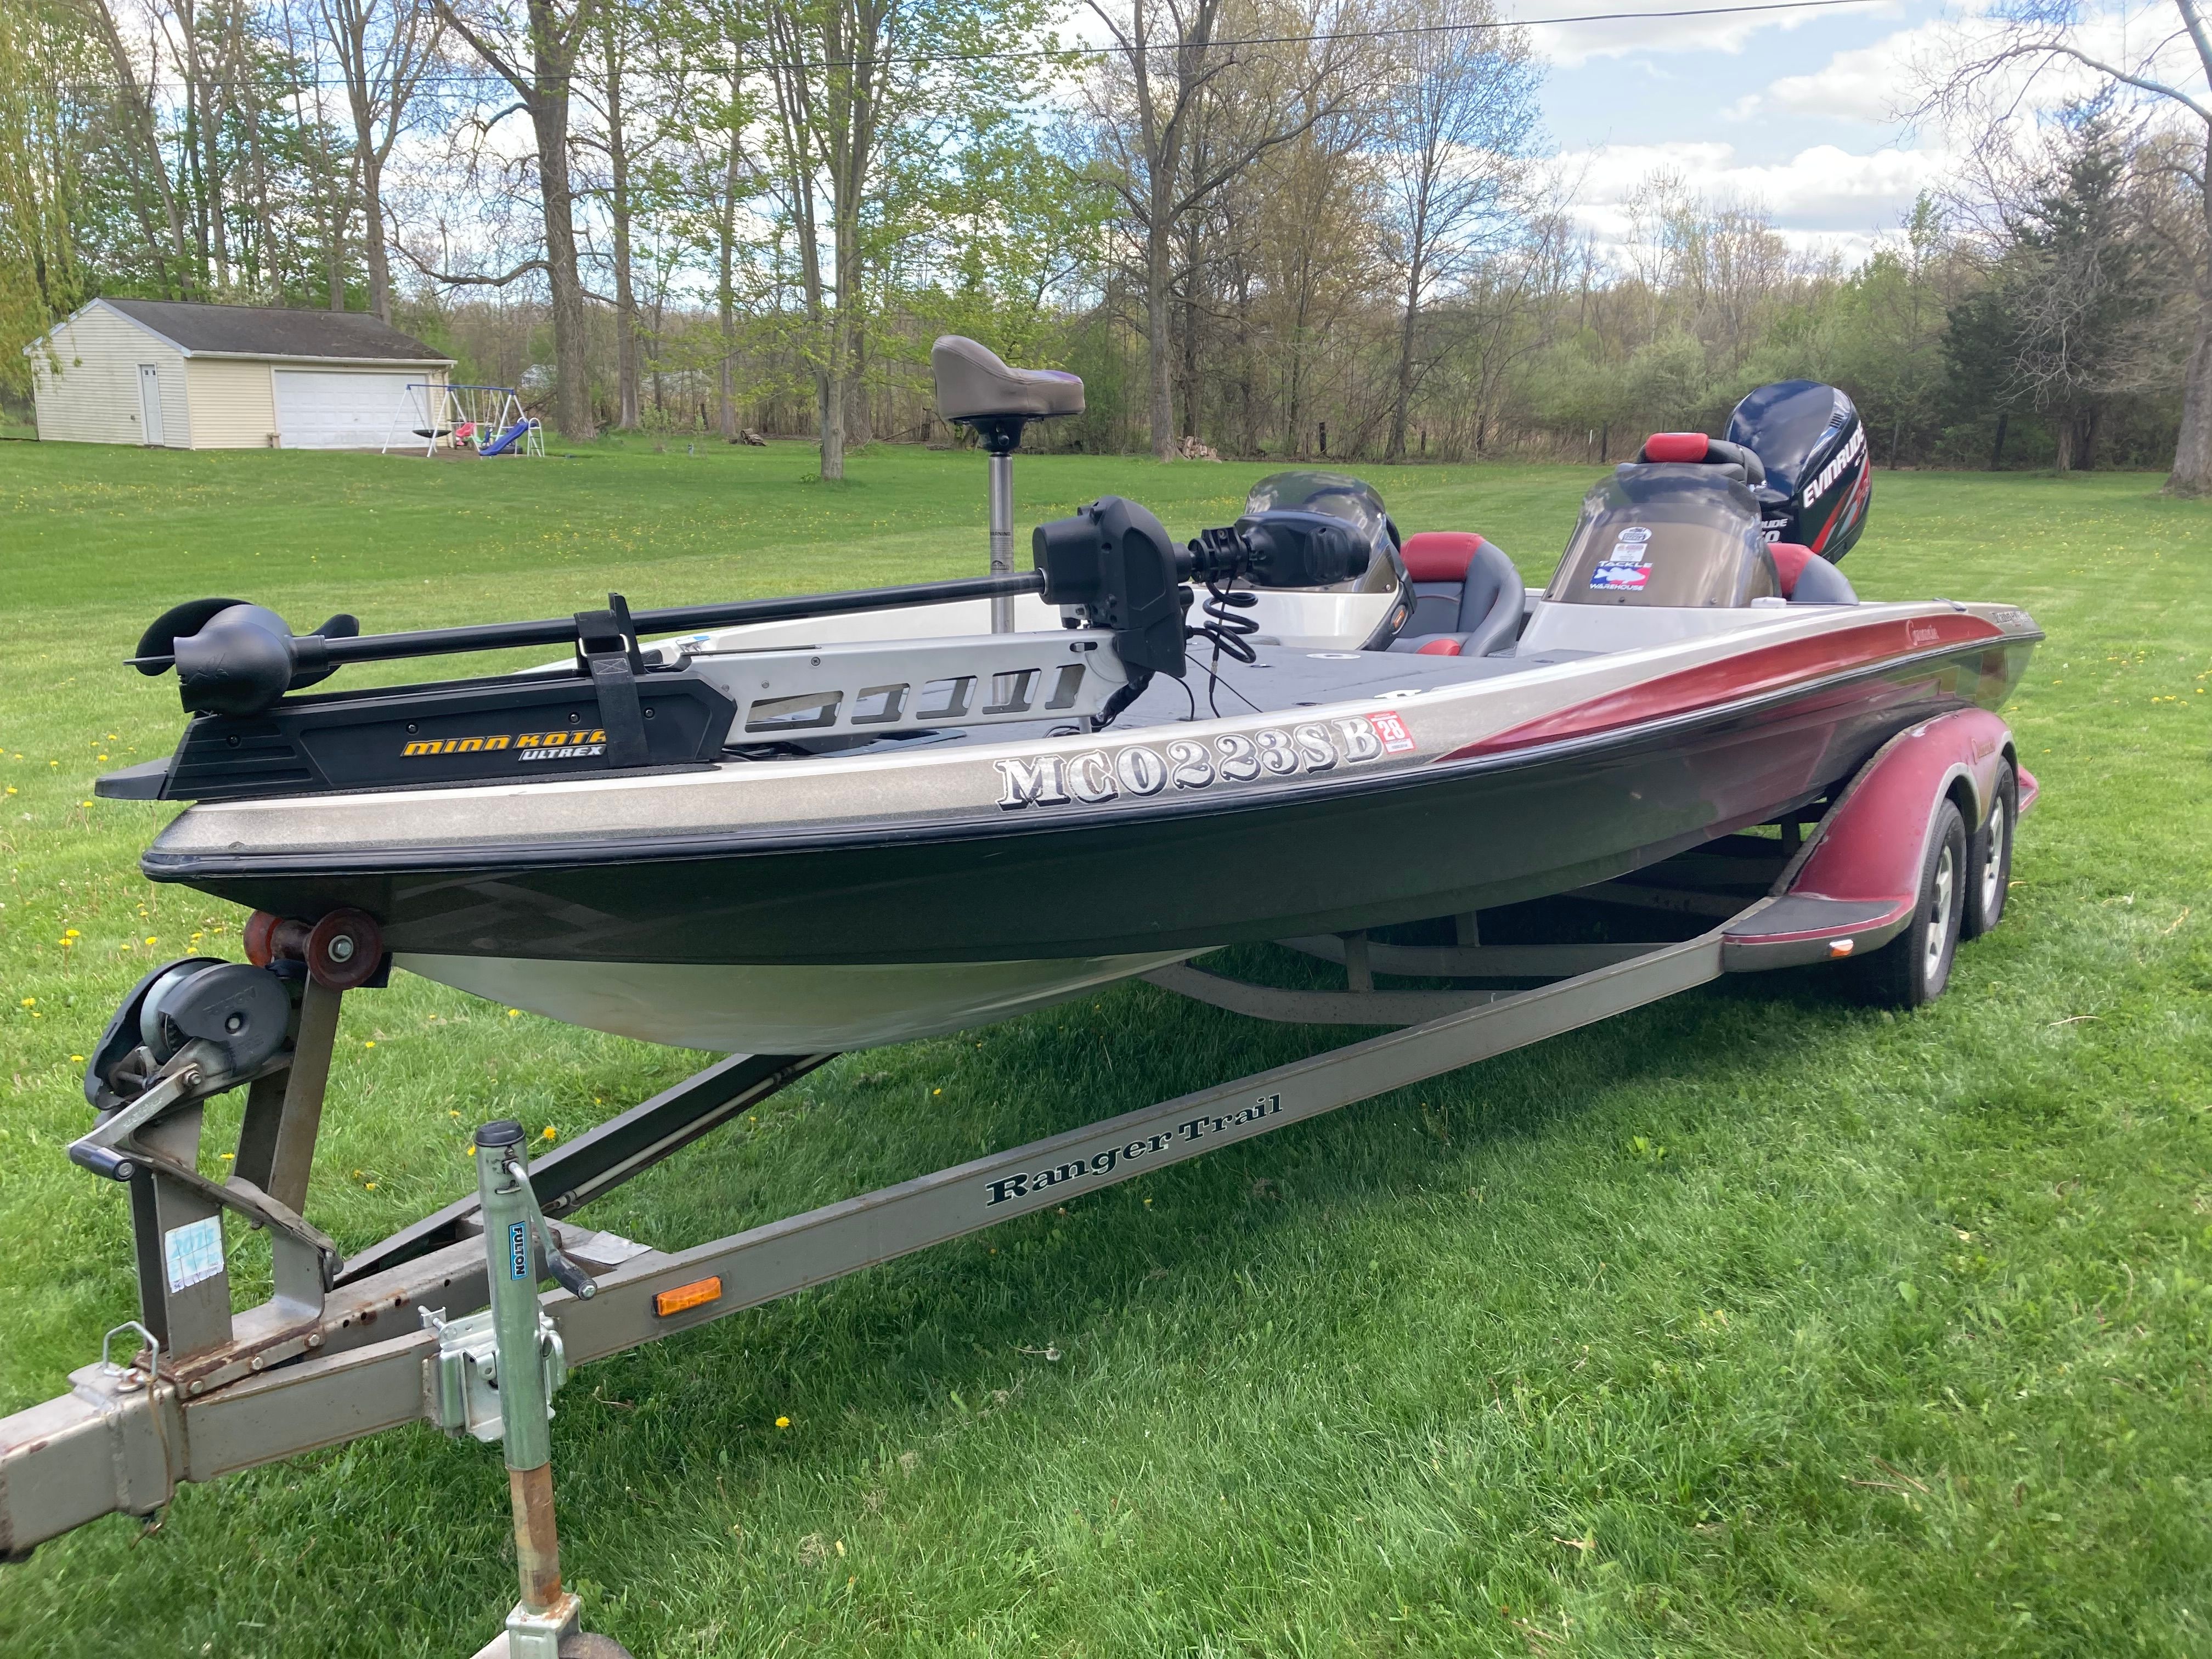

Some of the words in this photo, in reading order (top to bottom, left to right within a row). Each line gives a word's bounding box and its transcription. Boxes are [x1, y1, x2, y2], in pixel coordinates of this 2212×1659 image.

[1803, 420, 1865, 509] EVINRUDE
[515, 729, 607, 748] KOTA
[1376, 719, 1406, 741] 28
[520, 744, 604, 761] ULTREX
[985, 1130, 1172, 1208] Ranger
[1177, 1092, 1283, 1144] Trail
[513, 1226, 526, 1276] FULTON
